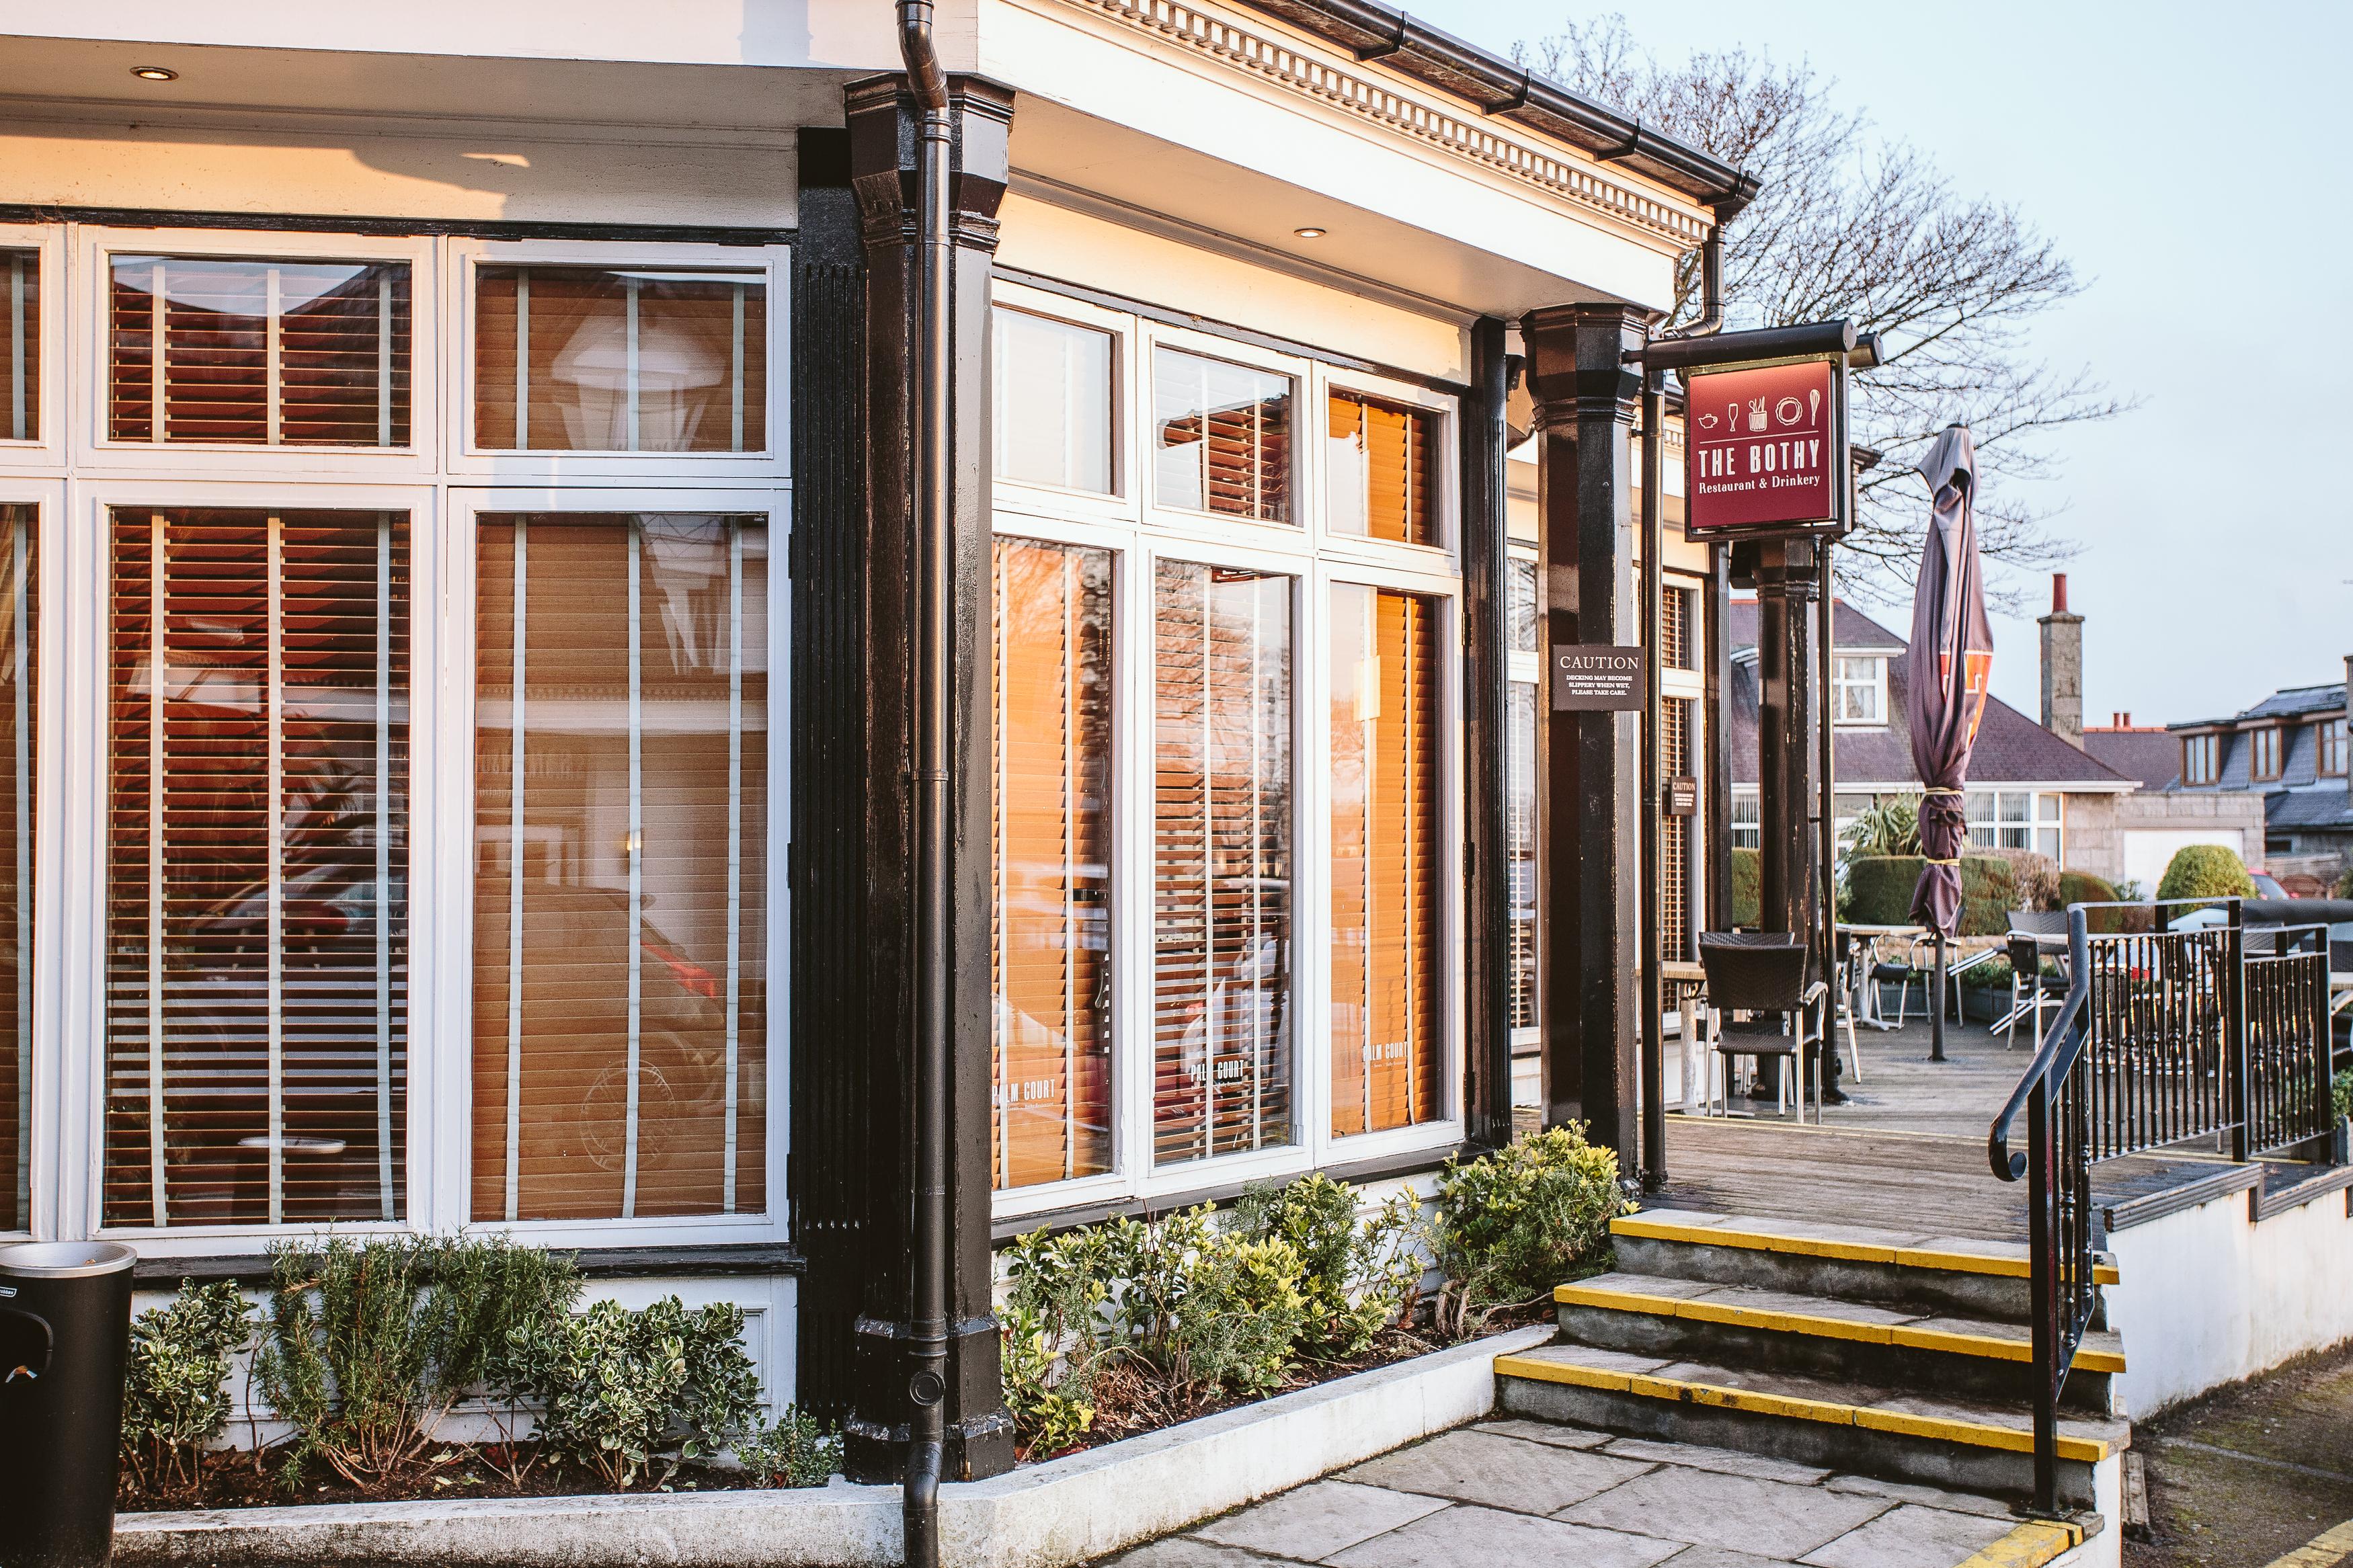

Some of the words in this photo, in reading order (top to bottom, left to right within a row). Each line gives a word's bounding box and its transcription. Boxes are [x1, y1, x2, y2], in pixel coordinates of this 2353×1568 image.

[1698, 448, 1736, 478] THE
[1750, 440, 1820, 473] BOTHY
[1699, 479, 1755, 494] Restaurant
[1759, 478, 1767, 489] &
[1771, 475, 1821, 488] Drinkery
[1560, 656, 1639, 669] CAUTION
[1673, 782, 1696, 791] CAUTION
[1386, 1042, 1407, 1059] COURT
[1218, 1059, 1244, 1079] COURT
[1024, 1079, 1055, 1101] COURT
